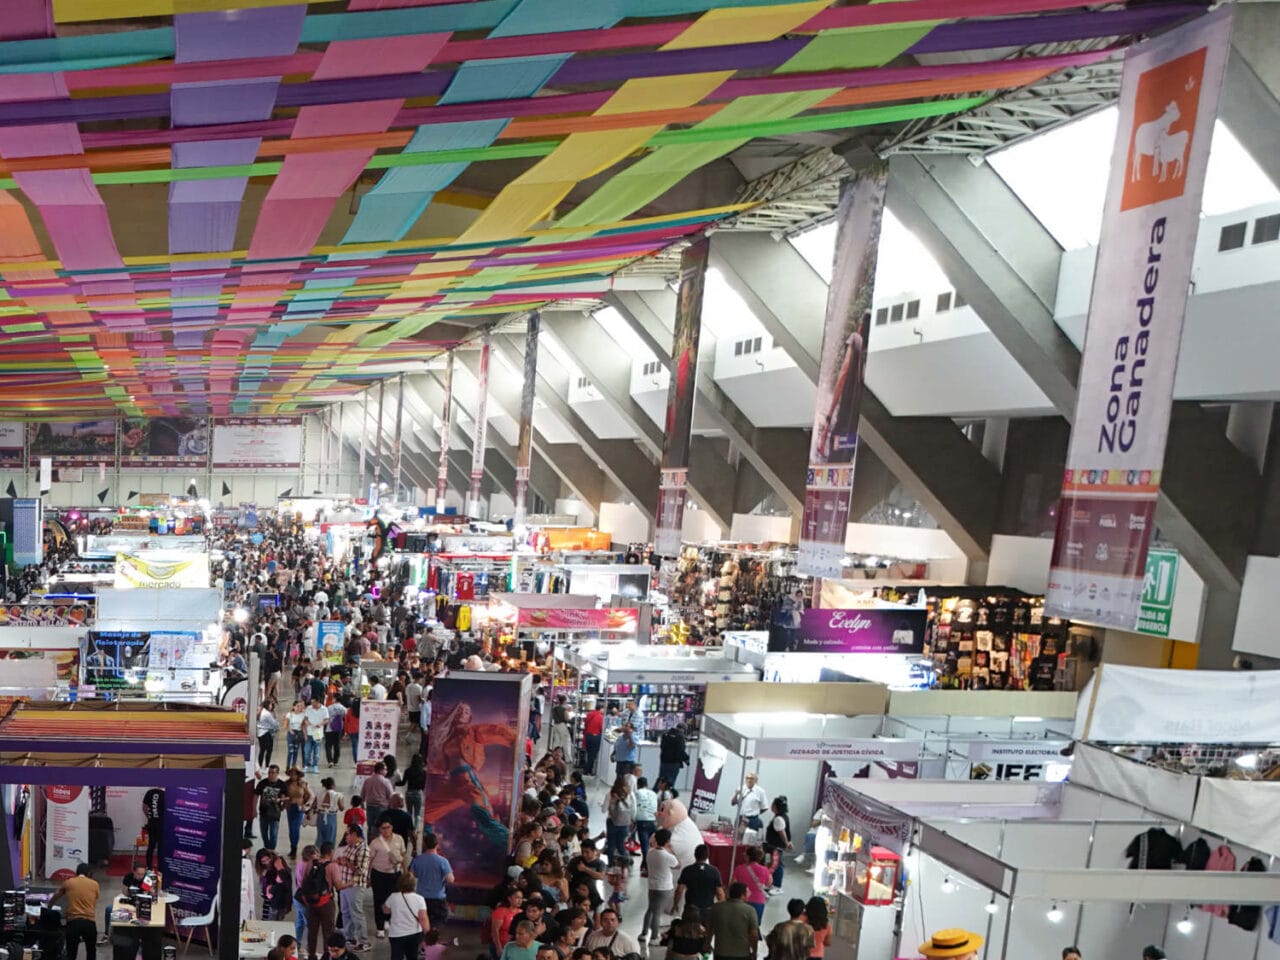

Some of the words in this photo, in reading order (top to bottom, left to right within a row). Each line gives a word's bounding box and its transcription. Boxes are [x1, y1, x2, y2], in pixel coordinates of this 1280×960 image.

[1117, 216, 1167, 453] Ganadera
[1098, 335, 1130, 453] Zona
[828, 610, 872, 633] Evelyn
[1024, 748, 1058, 756] ELECTORAL
